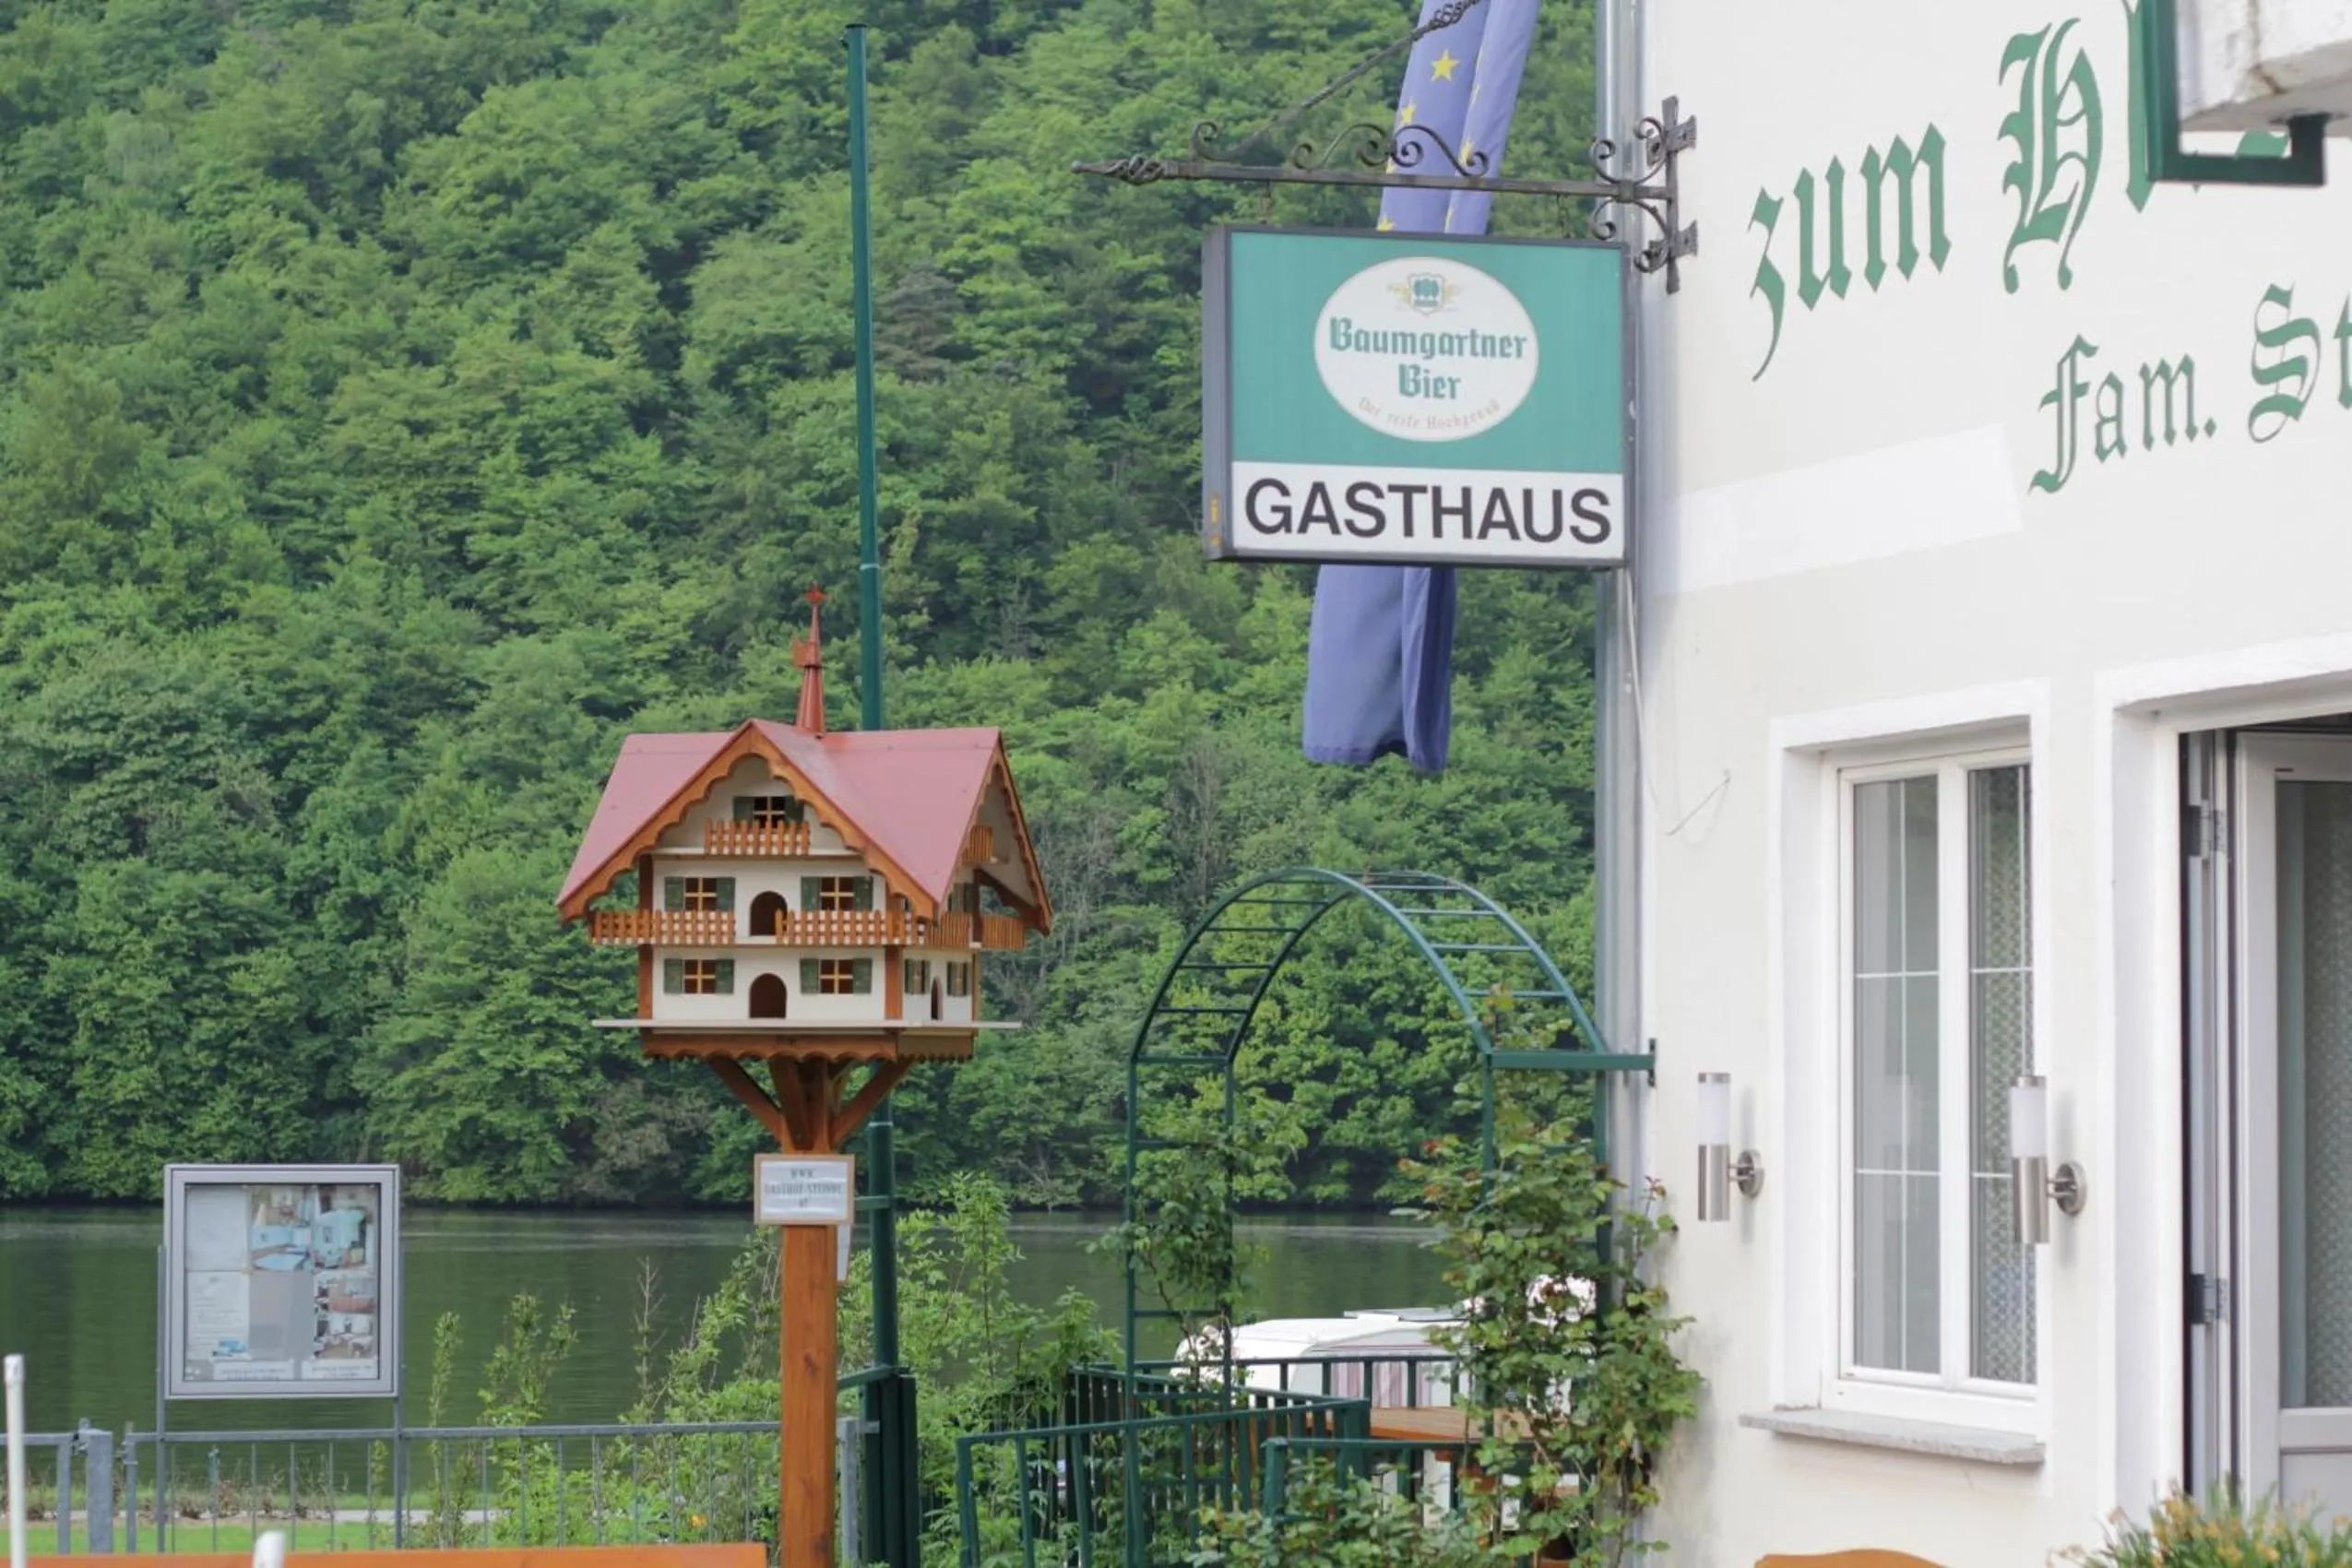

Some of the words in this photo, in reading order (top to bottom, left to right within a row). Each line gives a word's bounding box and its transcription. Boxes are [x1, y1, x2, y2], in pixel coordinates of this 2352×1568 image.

[1748, 122, 1952, 382] zum
[1329, 316, 1527, 360] Baumgartner
[1398, 363, 1461, 399] Bier
[1245, 478, 1611, 544] GASTHAUS
